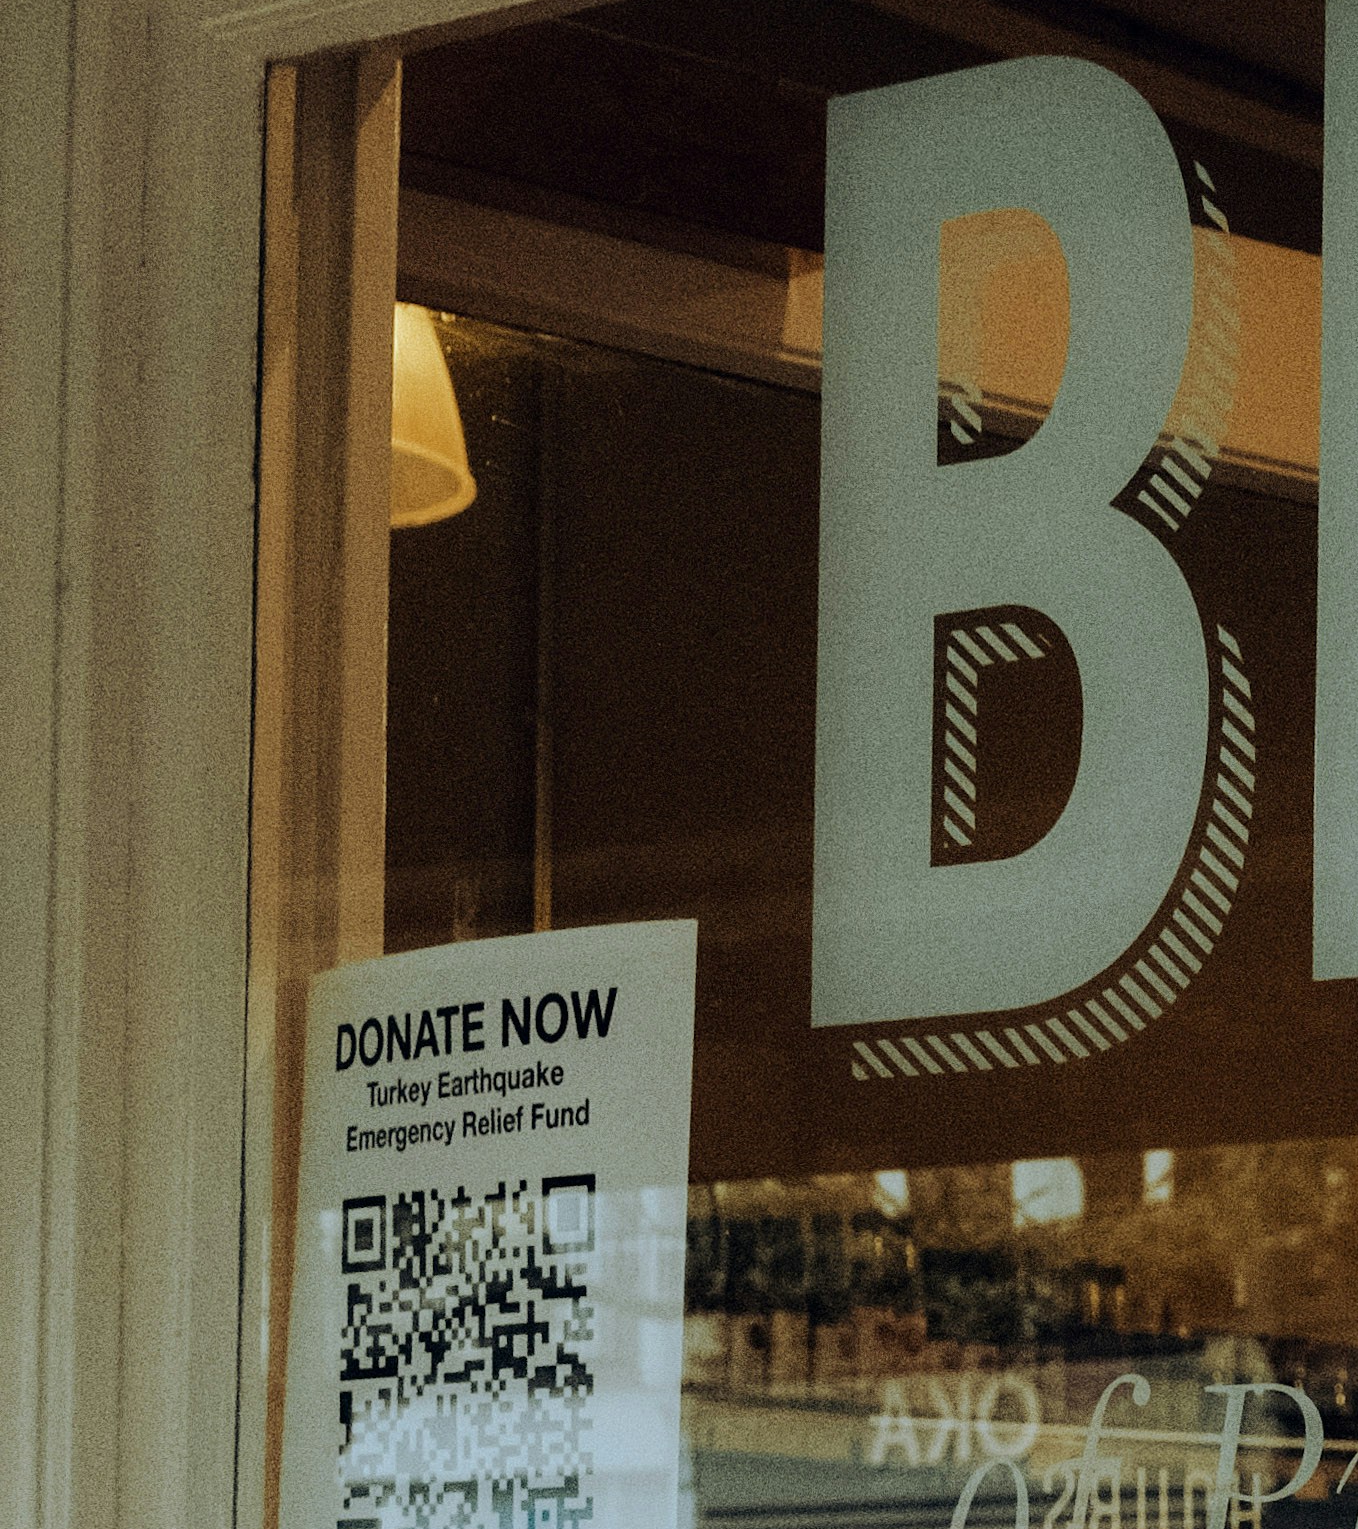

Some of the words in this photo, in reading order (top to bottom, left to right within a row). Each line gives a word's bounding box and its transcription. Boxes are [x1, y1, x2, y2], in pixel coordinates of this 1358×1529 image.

[336, 1001, 485, 1072] DONATE
[501, 987, 618, 1048] NOW
[367, 1080, 432, 1107] Turkey
[438, 1061, 564, 1099] Earthquake
[346, 1120, 455, 1153] Emergency
[462, 1104, 524, 1138] Relief
[531, 1098, 590, 1130] Fund
